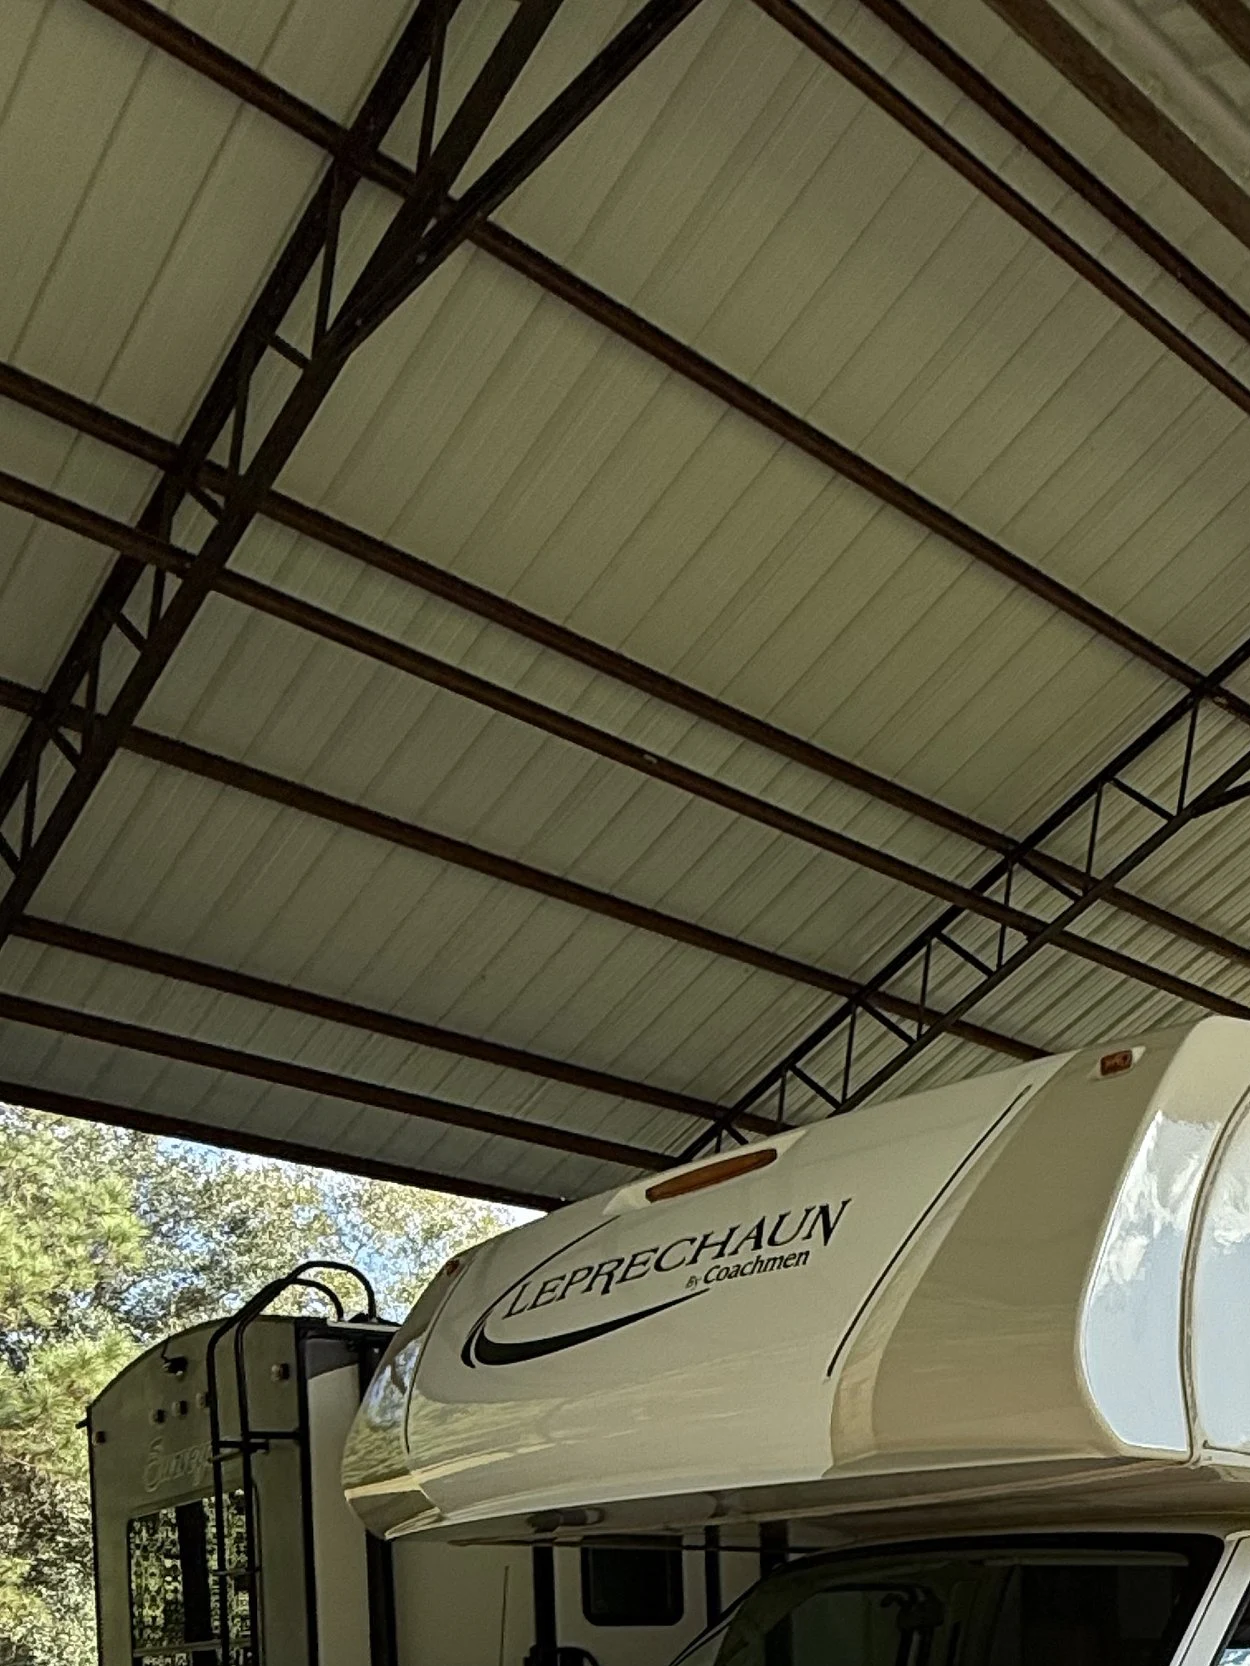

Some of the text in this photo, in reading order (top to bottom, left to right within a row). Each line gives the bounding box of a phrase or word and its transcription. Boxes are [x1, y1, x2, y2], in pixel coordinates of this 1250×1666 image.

[501, 1197, 853, 1320] LEPRECHAUN
[685, 1250, 810, 1291] By Coachmen
